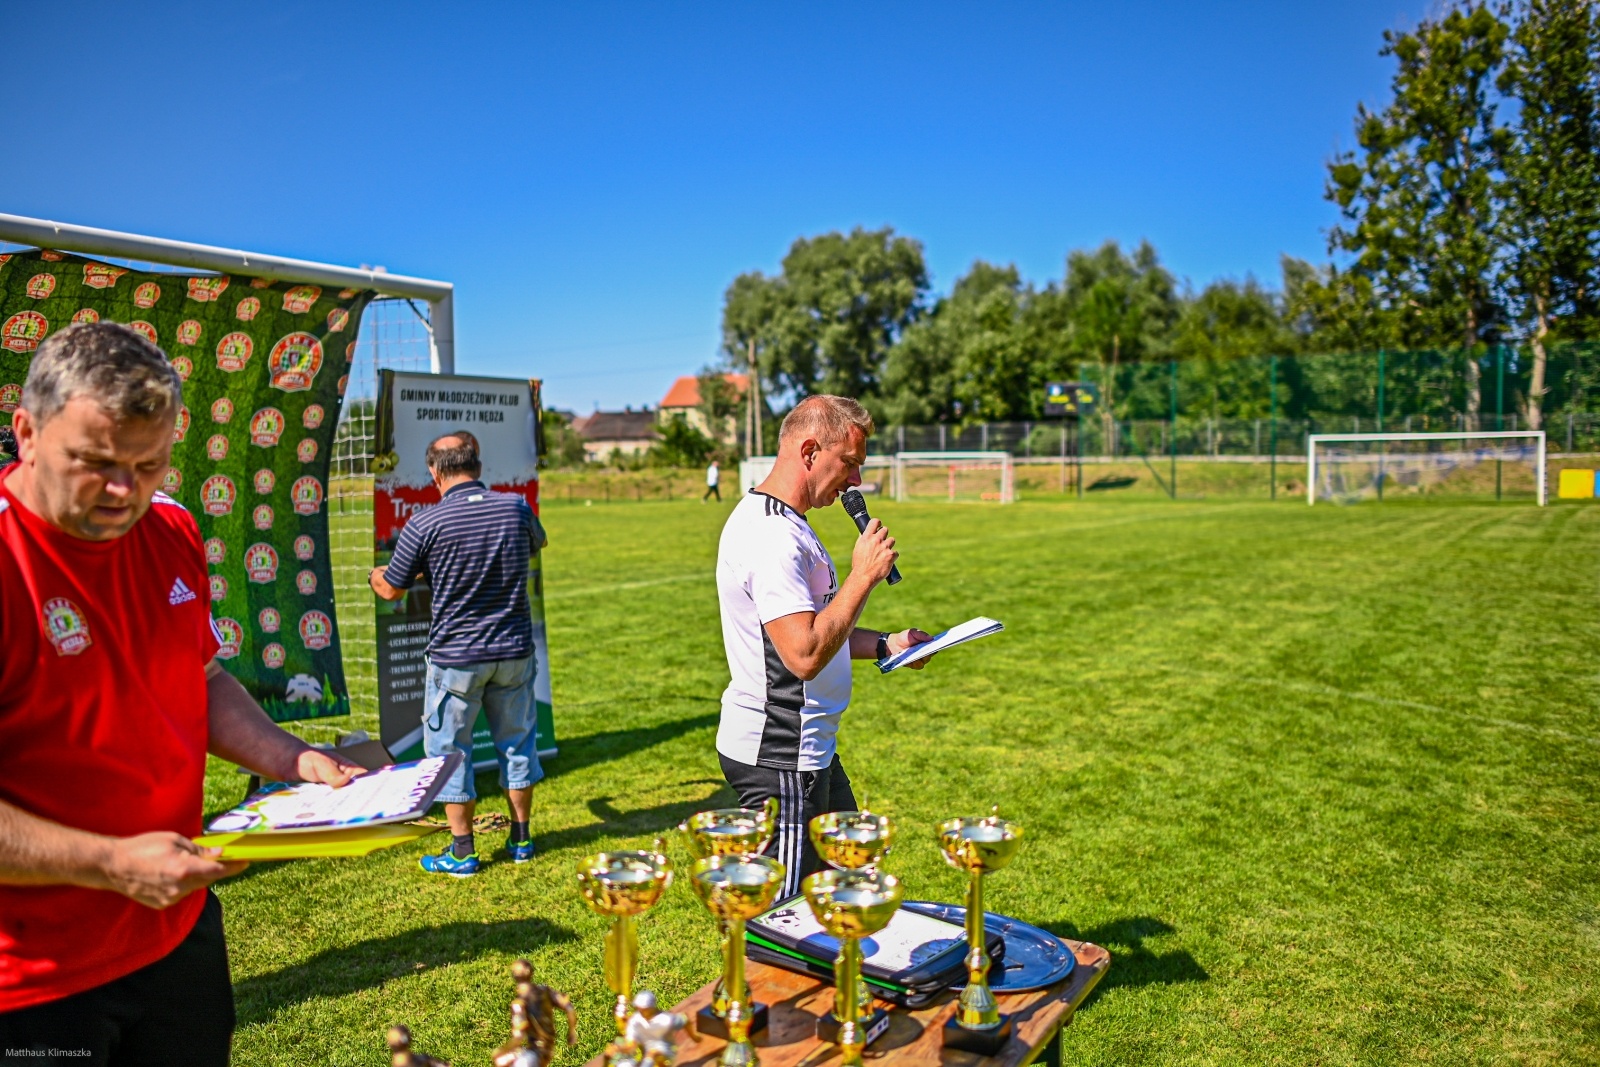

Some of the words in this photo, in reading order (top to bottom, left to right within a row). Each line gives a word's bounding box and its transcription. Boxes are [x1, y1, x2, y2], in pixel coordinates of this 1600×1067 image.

[400, 389, 436, 402] GMINNY
[438, 390, 497, 406] MŁODZIEŻOWY
[499, 394, 519, 406] KLUB
[417, 408, 463, 421] SPORTOWY
[465, 410, 477, 422] 21
[479, 411, 504, 424] NĘDZA
